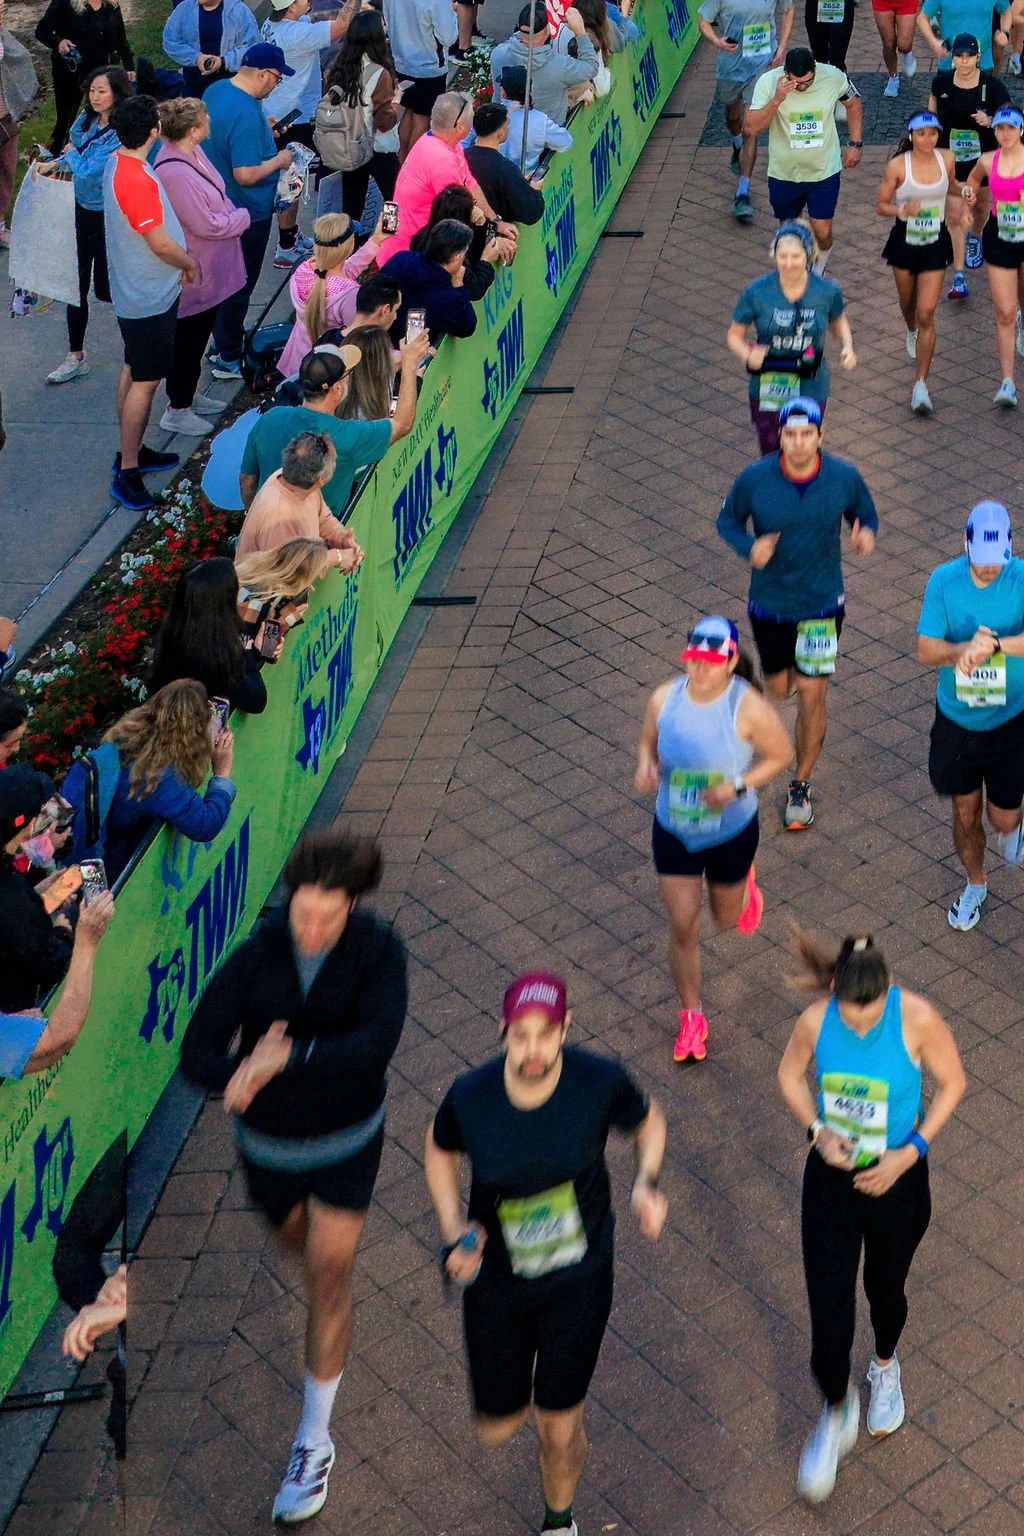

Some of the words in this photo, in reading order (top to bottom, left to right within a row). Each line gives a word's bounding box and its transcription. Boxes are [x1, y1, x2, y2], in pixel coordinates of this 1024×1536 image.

[639, 39, 661, 110] TWM
[589, 120, 613, 212] TWM
[796, 122, 817, 131] 3536
[541, 166, 573, 244] Methodist
[555, 194, 578, 280] TWM
[484, 262, 513, 334] KAG
[496, 293, 526, 402] TWM
[391, 441, 433, 580] TWM
[185, 814, 250, 1005] TWM
